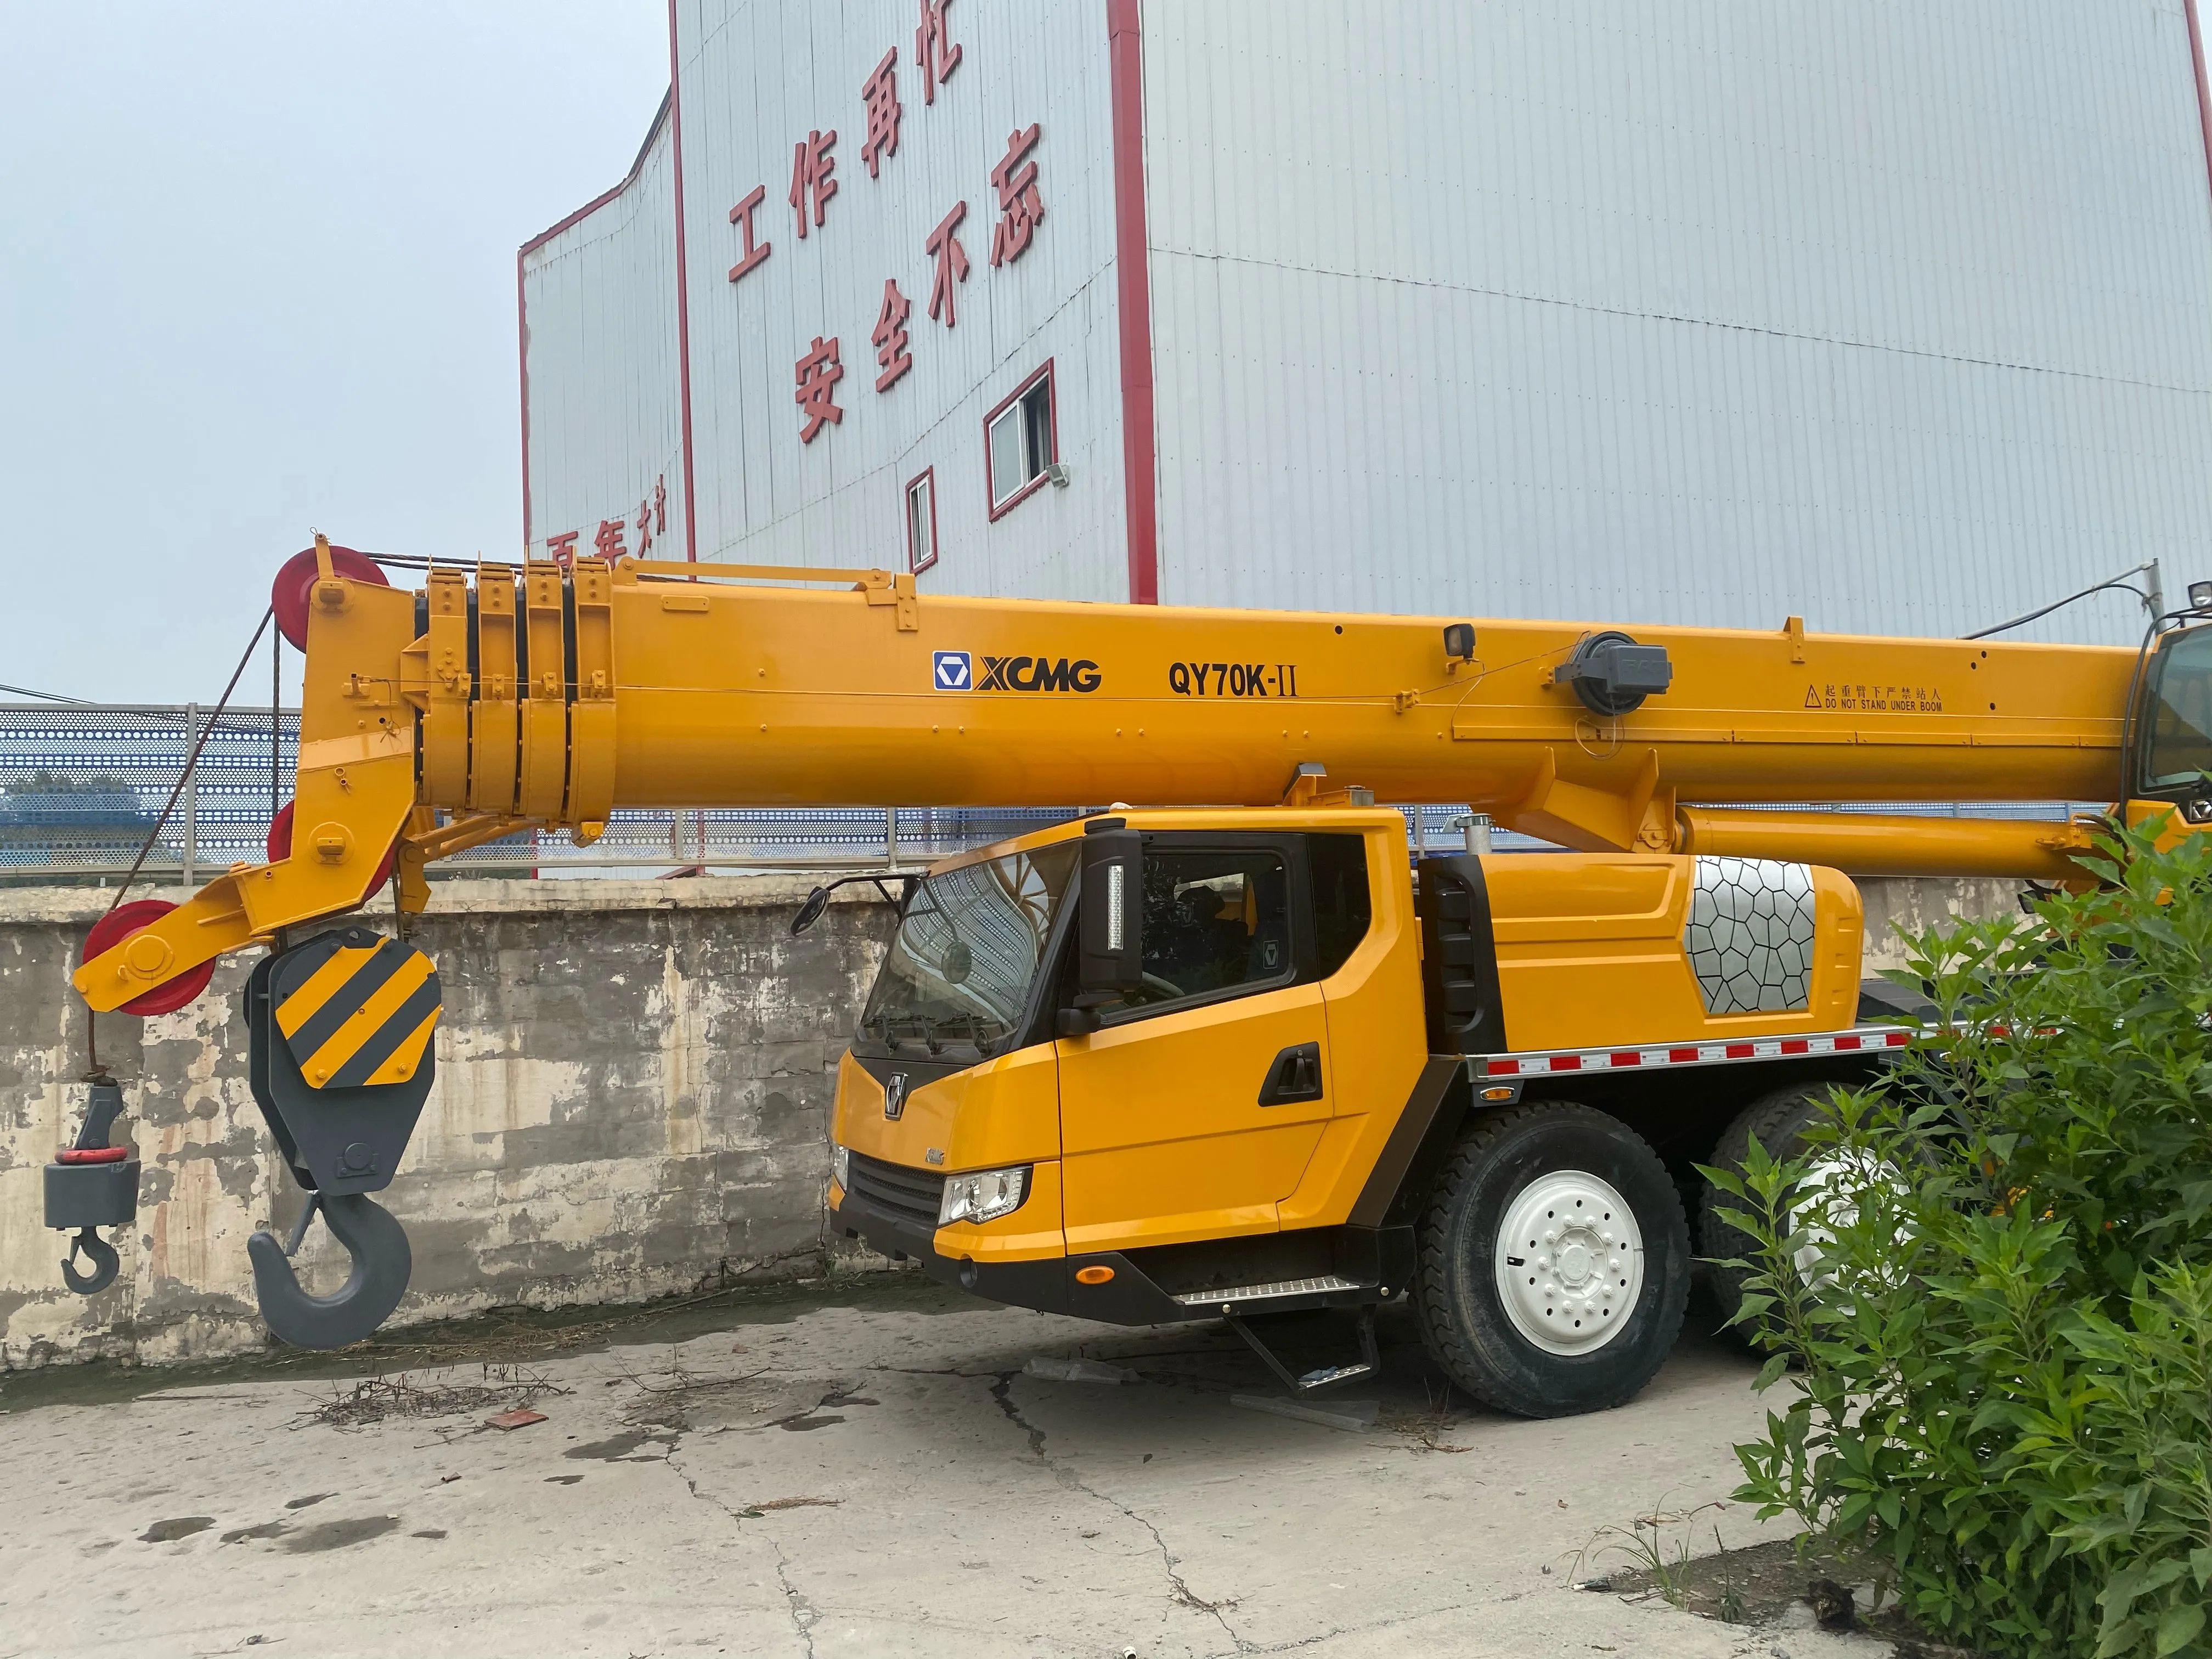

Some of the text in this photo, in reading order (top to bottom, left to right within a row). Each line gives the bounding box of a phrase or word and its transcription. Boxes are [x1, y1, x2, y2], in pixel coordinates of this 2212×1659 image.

[729, 0, 962, 283] 工作再忙
[795, 123, 1045, 443] 安全不忘
[974, 656, 1102, 693] XCMG
[1825, 684, 1941, 701] 起重臂下严禁站人
[1825, 698, 1942, 712] DO NOT STAND UNDER BOOM
